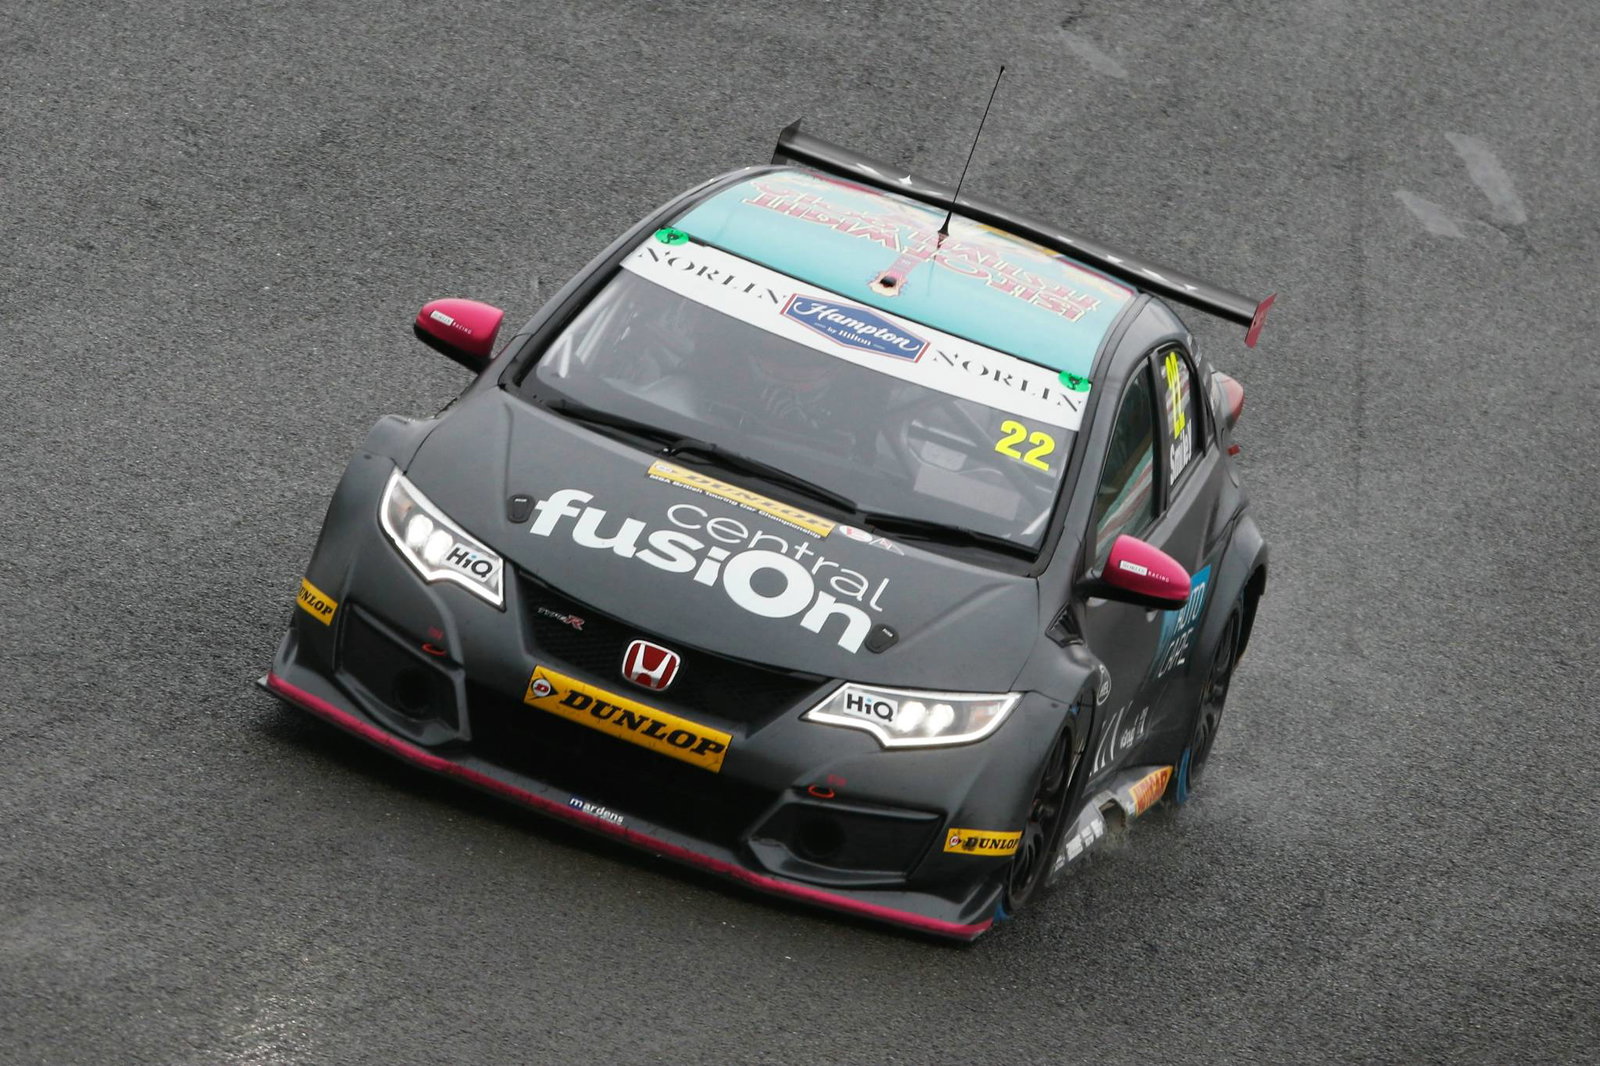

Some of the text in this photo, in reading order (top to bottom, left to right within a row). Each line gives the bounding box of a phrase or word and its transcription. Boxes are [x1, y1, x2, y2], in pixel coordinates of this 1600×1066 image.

[638, 247, 787, 305] NORLIN
[793, 301, 920, 352] Hampton
[838, 330, 872, 347] Hilton
[933, 349, 1082, 413] NORLIN
[995, 419, 1056, 472] 22
[446, 547, 493, 578] HiQ
[667, 503, 890, 612] central
[559, 689, 726, 756] DUNLOP
[846, 693, 894, 722] HiQ
[570, 797, 624, 824] mardens
